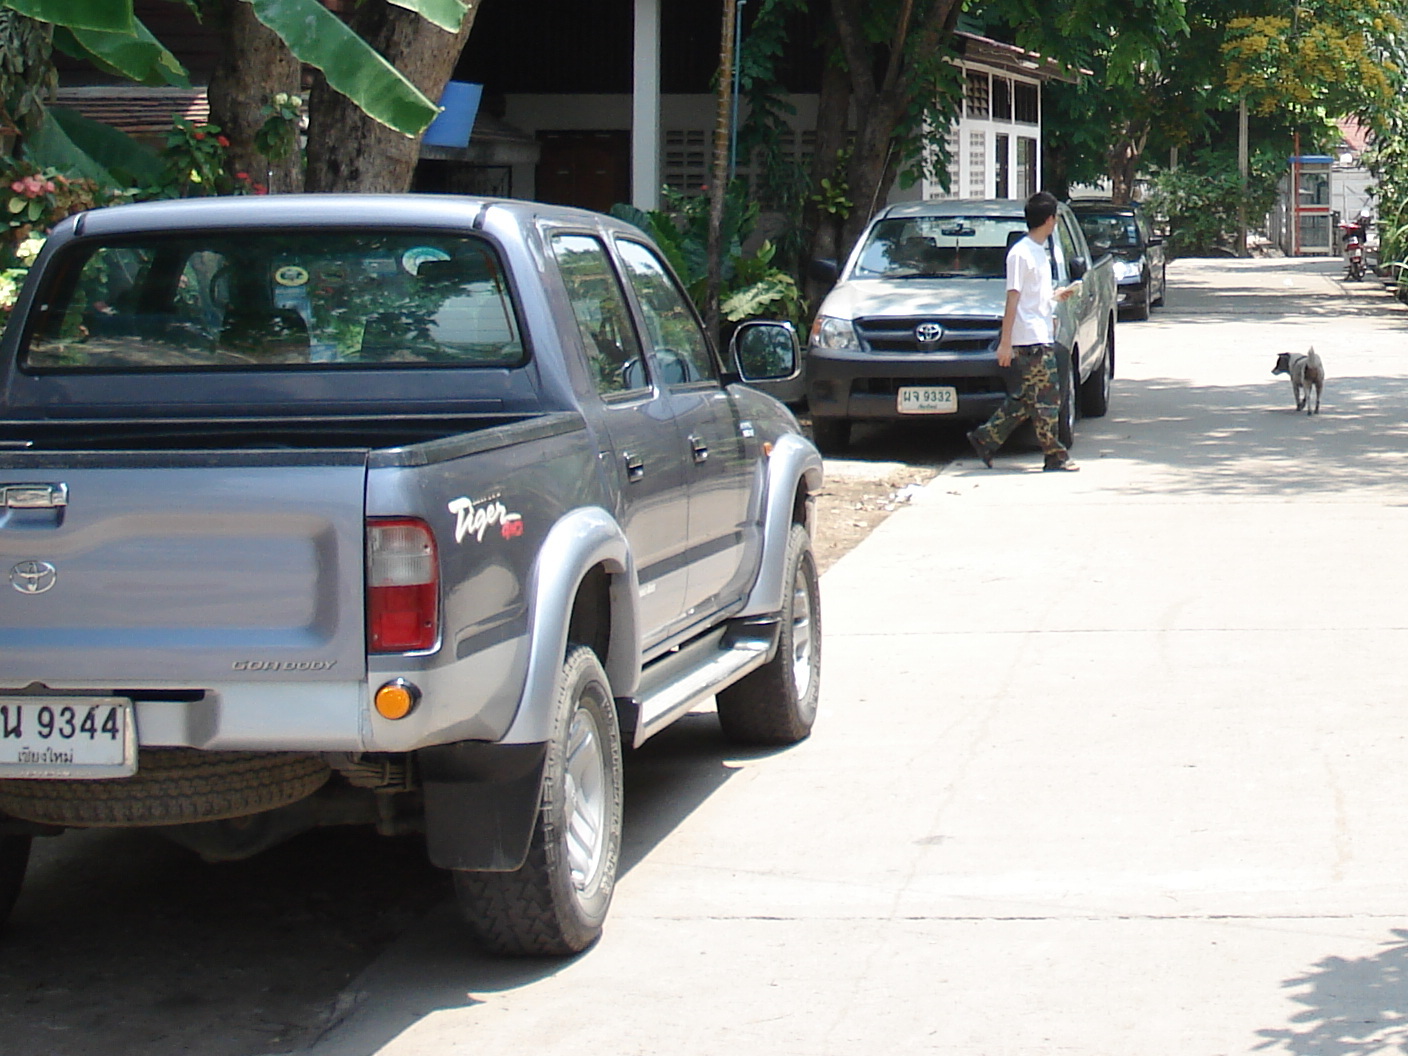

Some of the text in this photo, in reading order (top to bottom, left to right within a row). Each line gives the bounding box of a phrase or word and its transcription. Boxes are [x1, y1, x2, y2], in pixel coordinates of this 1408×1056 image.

[923, 391, 951, 402] 9332
[448, 496, 522, 544] Tiger
[282, 659, 338, 671] BODY
[37, 705, 119, 740] 9344
[18, 746, 73, 764] เชียงใหม่
